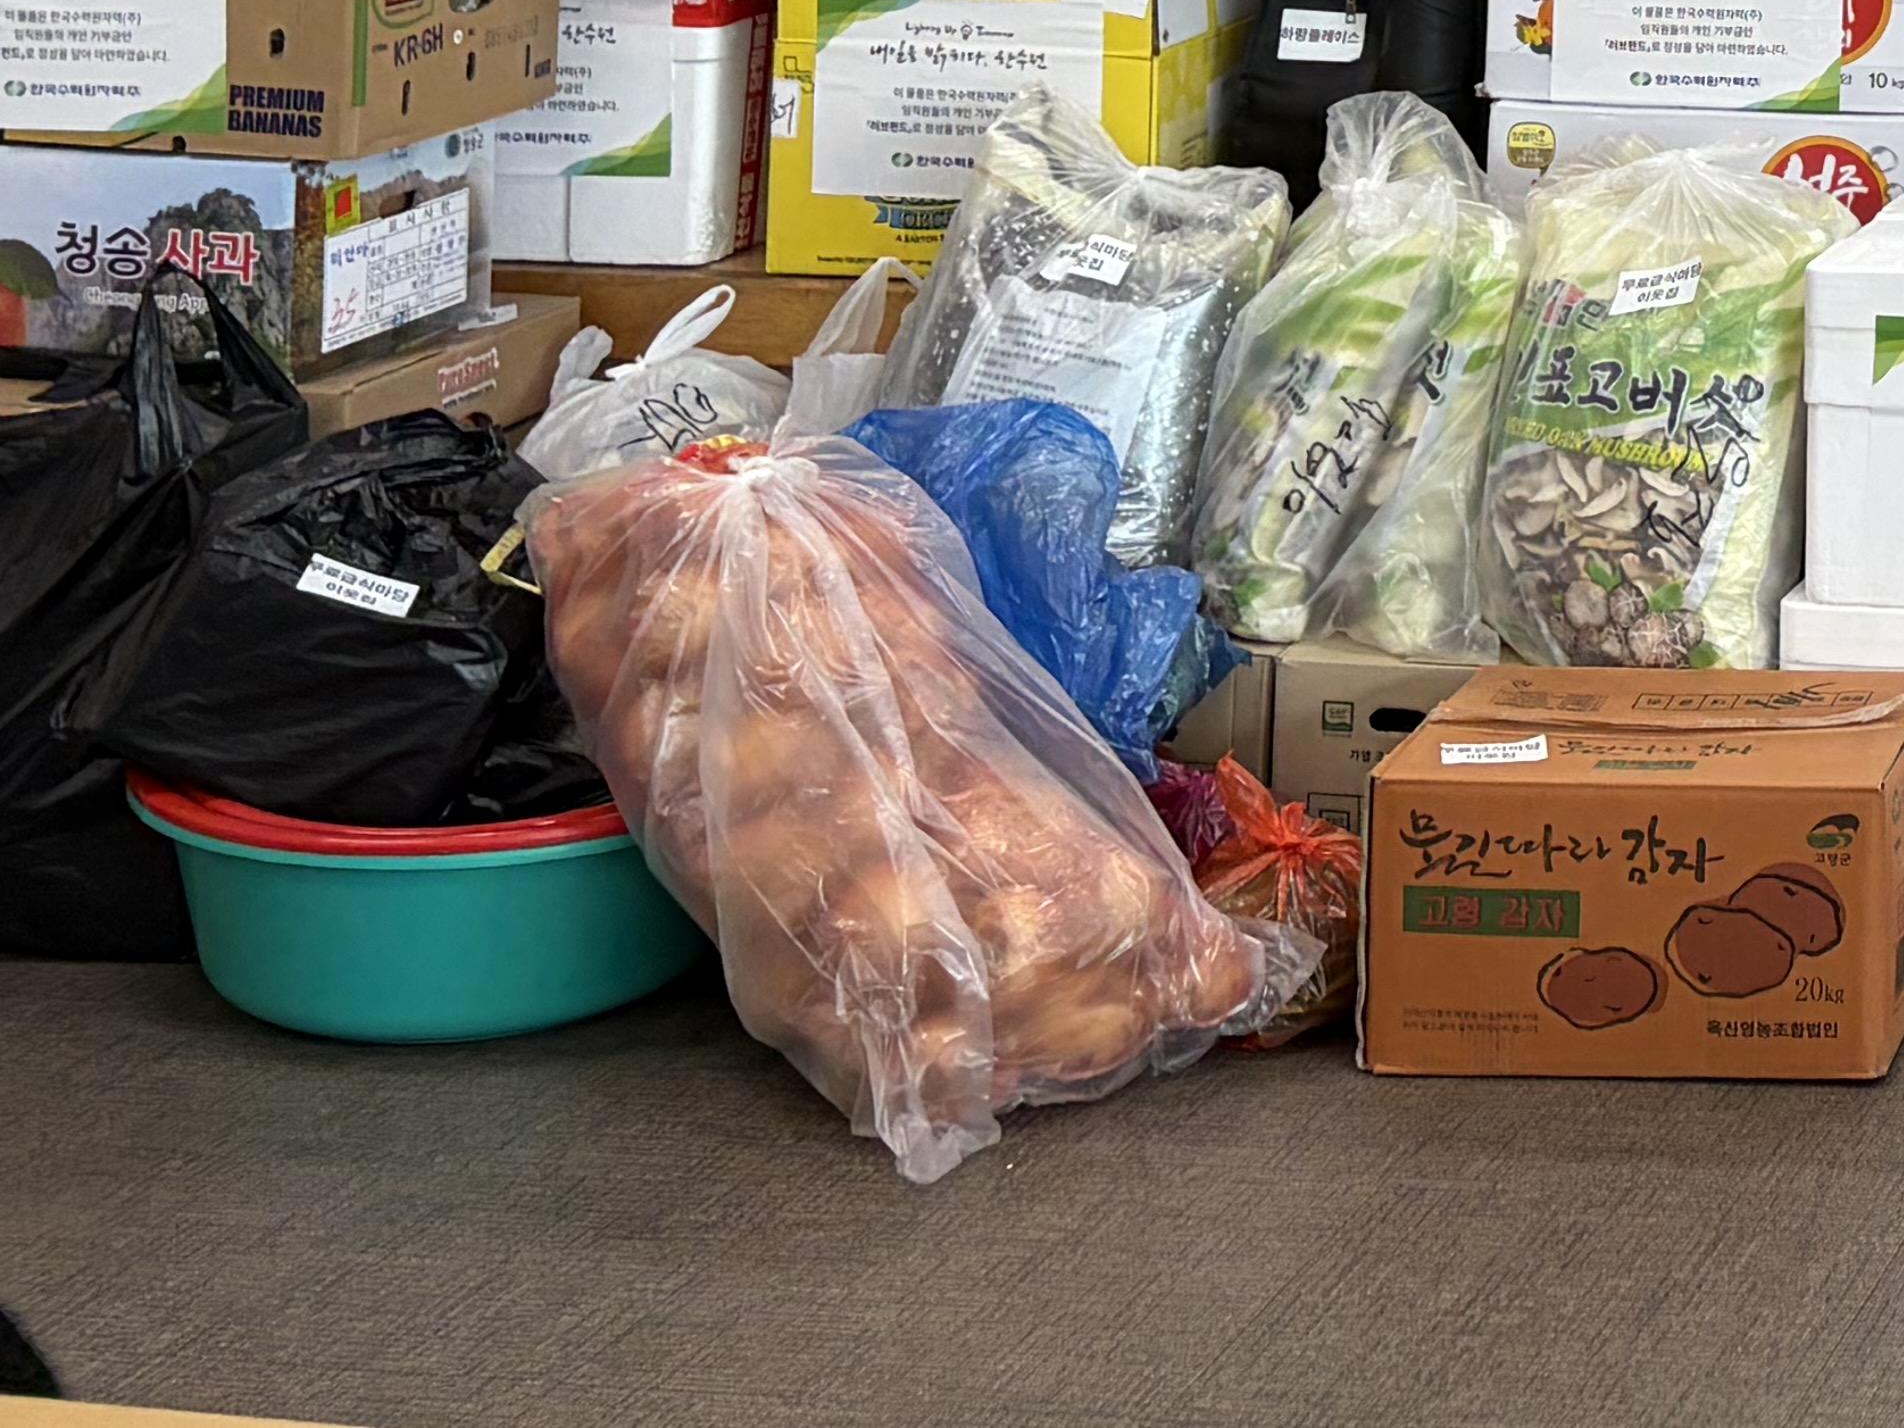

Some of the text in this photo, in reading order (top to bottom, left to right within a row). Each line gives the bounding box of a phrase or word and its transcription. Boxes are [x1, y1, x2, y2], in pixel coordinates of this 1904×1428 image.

[229, 84, 325, 114] PREMIUM
[228, 111, 323, 140] BANANAS
[55, 220, 260, 286] 청송 사과
[1621, 815, 1725, 885] 감자
[1417, 894, 1481, 930] 고령
[1794, 975, 1845, 1007] 20kg
